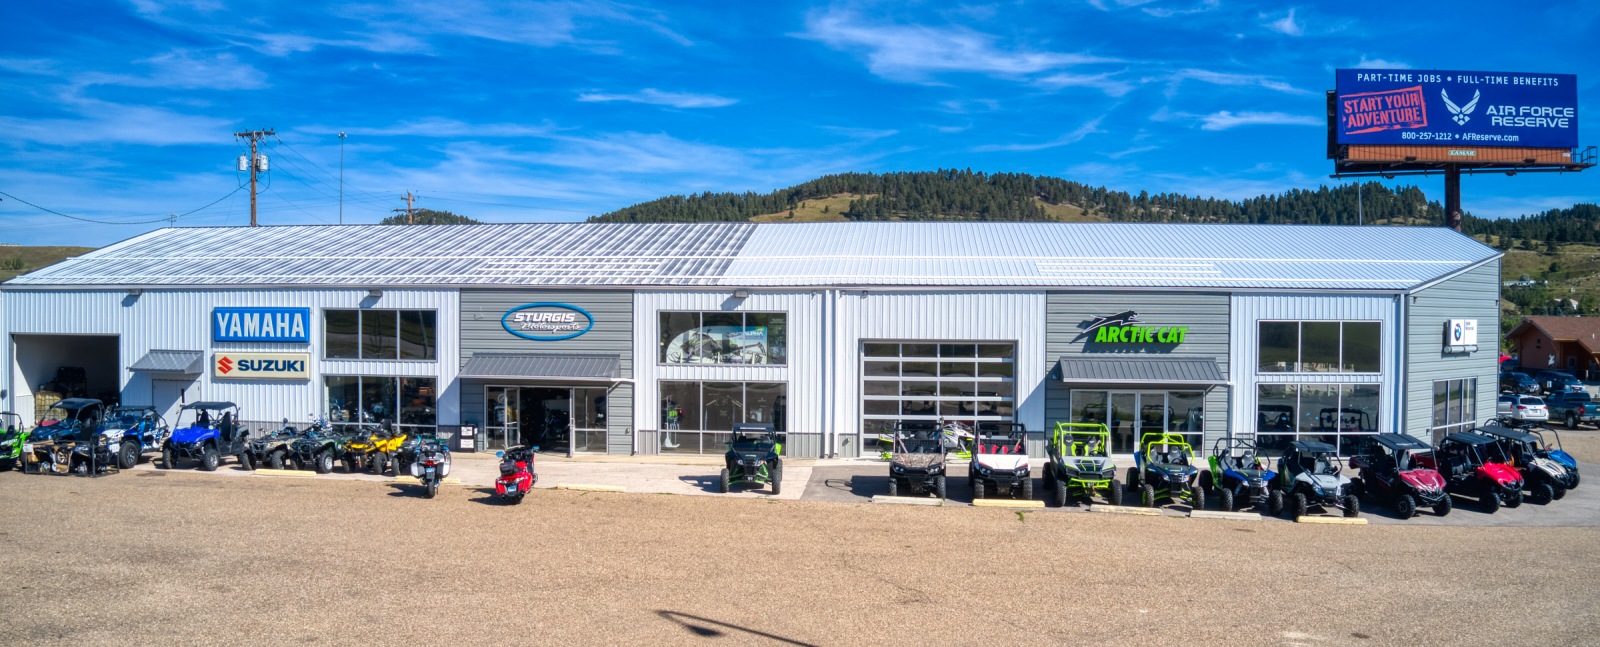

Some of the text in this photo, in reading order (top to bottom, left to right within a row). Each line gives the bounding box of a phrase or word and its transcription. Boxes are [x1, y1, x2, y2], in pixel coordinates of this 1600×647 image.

[1357, 73, 1559, 86] PART-TIME JOBS FULL-TIME BENEFITS
[1344, 92, 1419, 114] START YOUR
[1347, 107, 1421, 127] ADVENTURE
[1486, 105, 1574, 118] AIR FORCE
[1491, 116, 1569, 128] RESERVE
[1401, 132, 1519, 142] 800-257-1212 AFReserve.com
[514, 312, 575, 322] STURGIS
[216, 313, 305, 337] YAMAHA
[521, 322, 581, 333] Motorsports
[1094, 326, 1189, 343] ARCTIC CAT
[237, 359, 305, 371] SUZUKI
